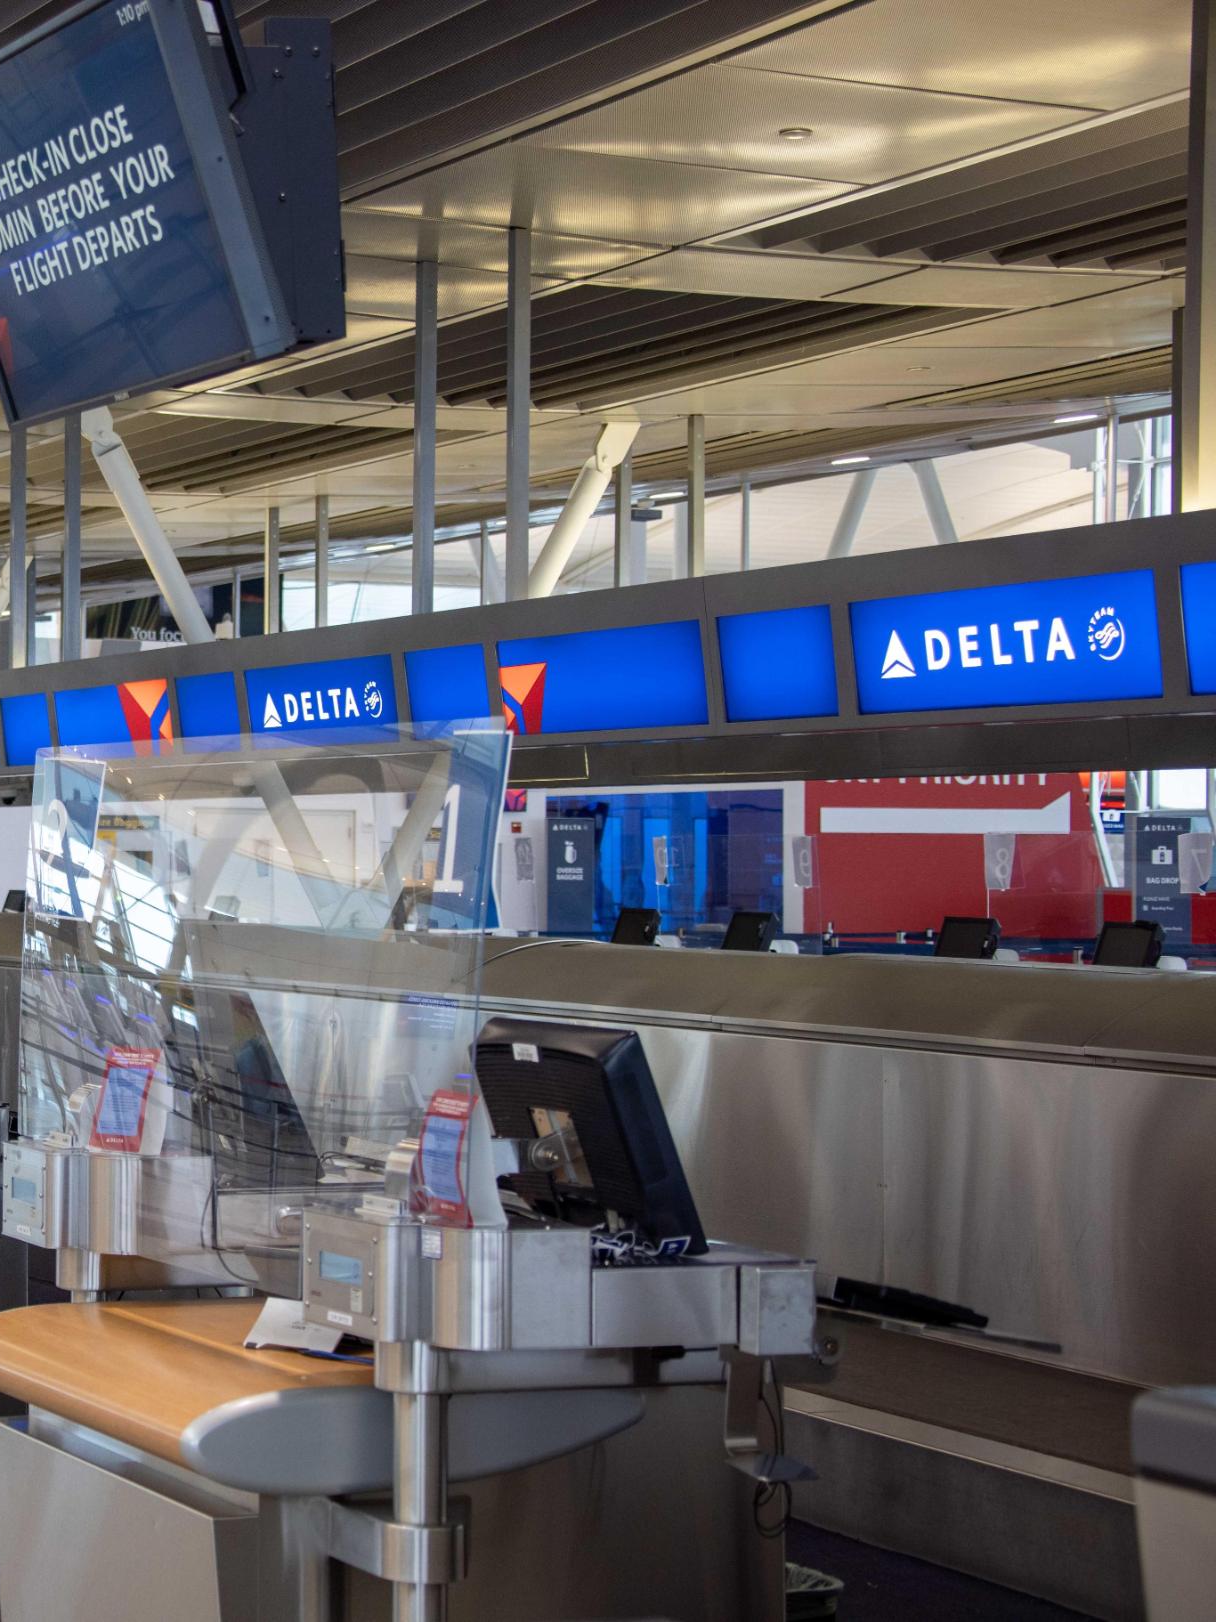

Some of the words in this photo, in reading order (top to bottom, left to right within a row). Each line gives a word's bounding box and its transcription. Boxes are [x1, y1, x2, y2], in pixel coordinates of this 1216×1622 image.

[116, 4, 135, 26] 1:10
[69, 104, 133, 164] CLOSE
[37, 172, 110, 233] BEFORE
[109, 144, 175, 199] YOUR
[10, 241, 72, 296] FLIGHT
[72, 204, 163, 271] DEPARTS
[131, 626, 156, 641] You
[924, 617, 1076, 671] DELTA
[283, 687, 360, 723] DELTA
[433, 784, 464, 893] 1
[1151, 824, 1176, 832] DELTA
